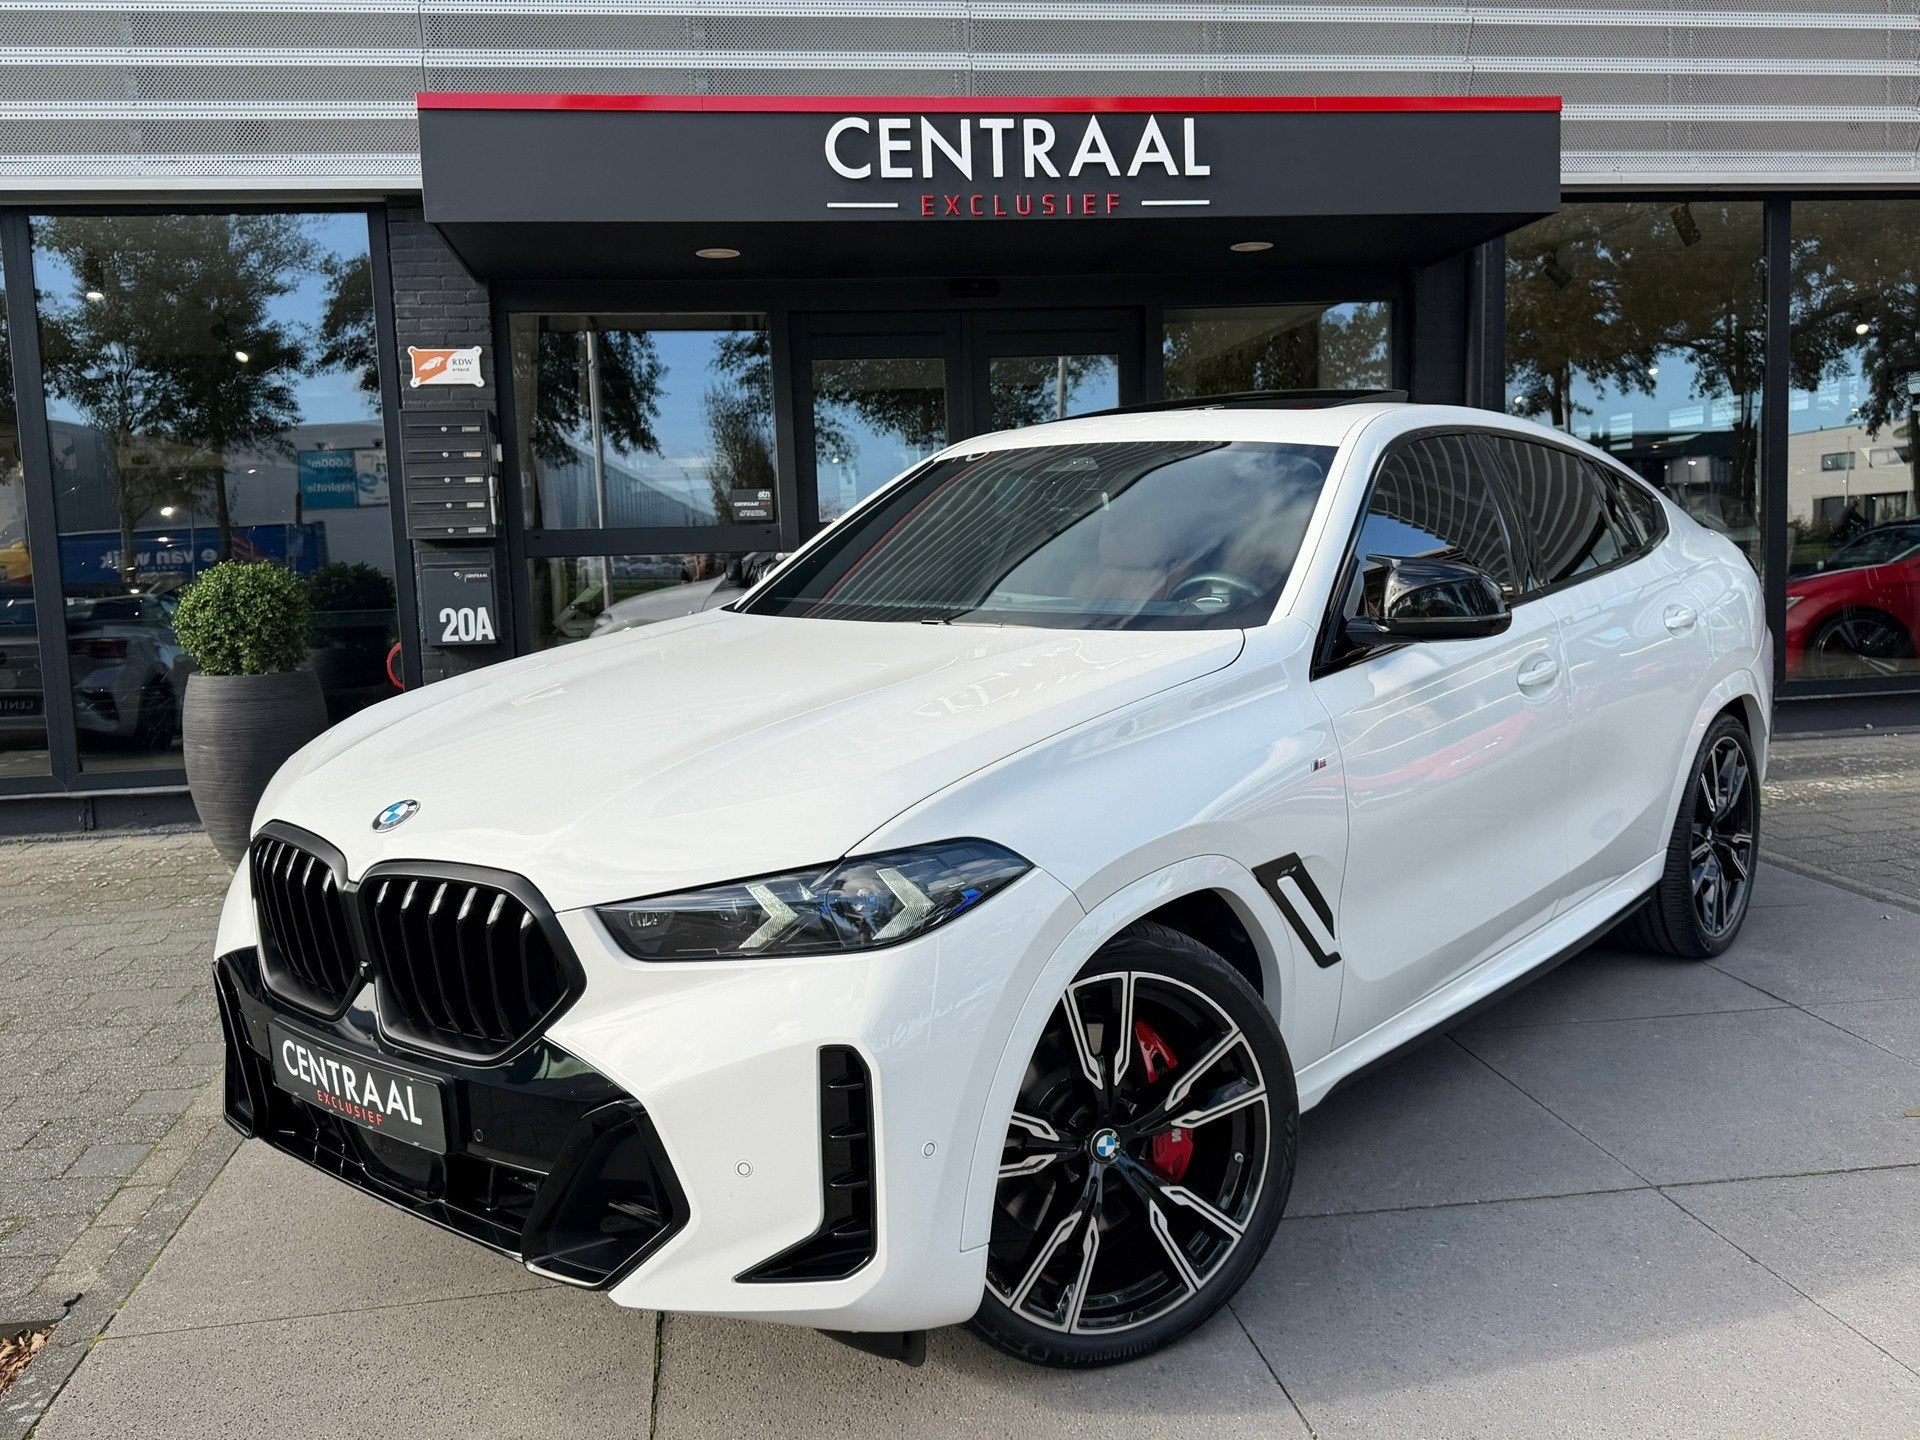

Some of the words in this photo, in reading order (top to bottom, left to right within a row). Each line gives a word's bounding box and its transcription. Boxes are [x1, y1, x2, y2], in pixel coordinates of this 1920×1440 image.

[824, 114, 1211, 181] CENTRAAL
[921, 193, 1121, 216] EXCLUSIEF
[439, 606, 496, 643] 20A
[282, 1039, 423, 1126] CENTRAAL
[316, 1088, 384, 1126] EXCLUSIEF
